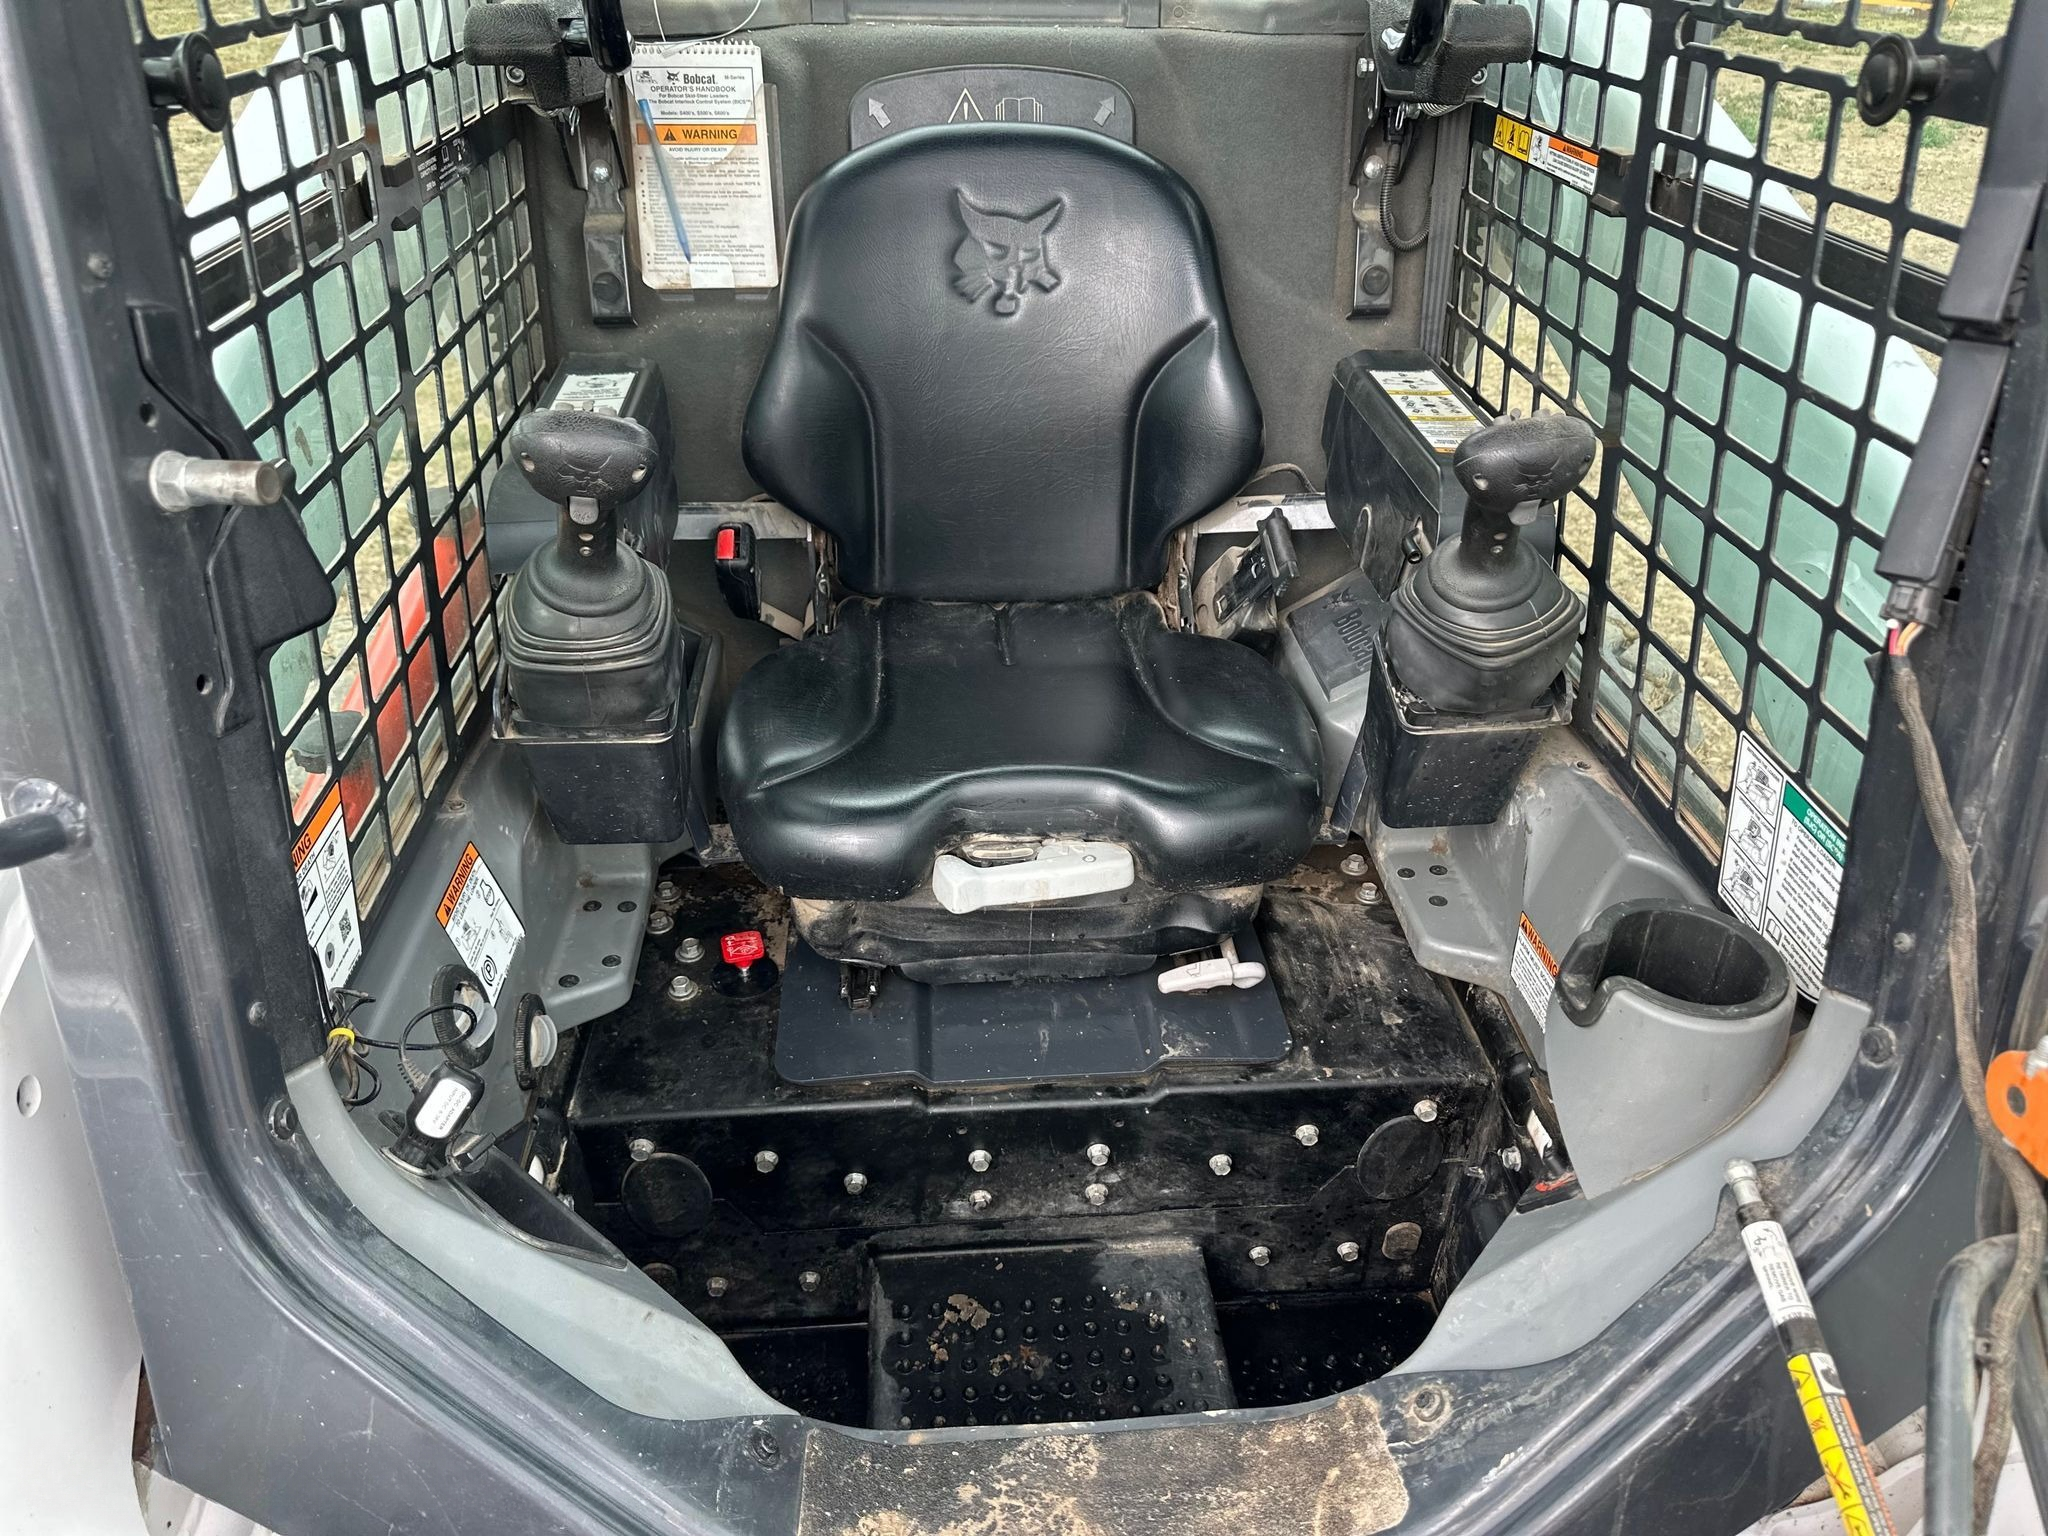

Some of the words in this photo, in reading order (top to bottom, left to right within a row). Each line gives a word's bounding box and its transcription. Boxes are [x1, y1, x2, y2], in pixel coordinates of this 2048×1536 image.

[683, 74, 716, 85] Bobcat
[682, 129, 738, 139] WARNING
[1332, 607, 1373, 671] Bobcat
[1792, 818, 1797, 827] TO
[1798, 826, 1817, 849] OPERATE
[1807, 808, 1836, 841] OPERATION
[1817, 830, 1826, 842] OR
[292, 832, 312, 868] NING
[302, 850, 316, 876] DEATH
[447, 853, 473, 907] WARNING
[1527, 928, 1558, 977] WARNING
[439, 1107, 454, 1129] ADAPTER
